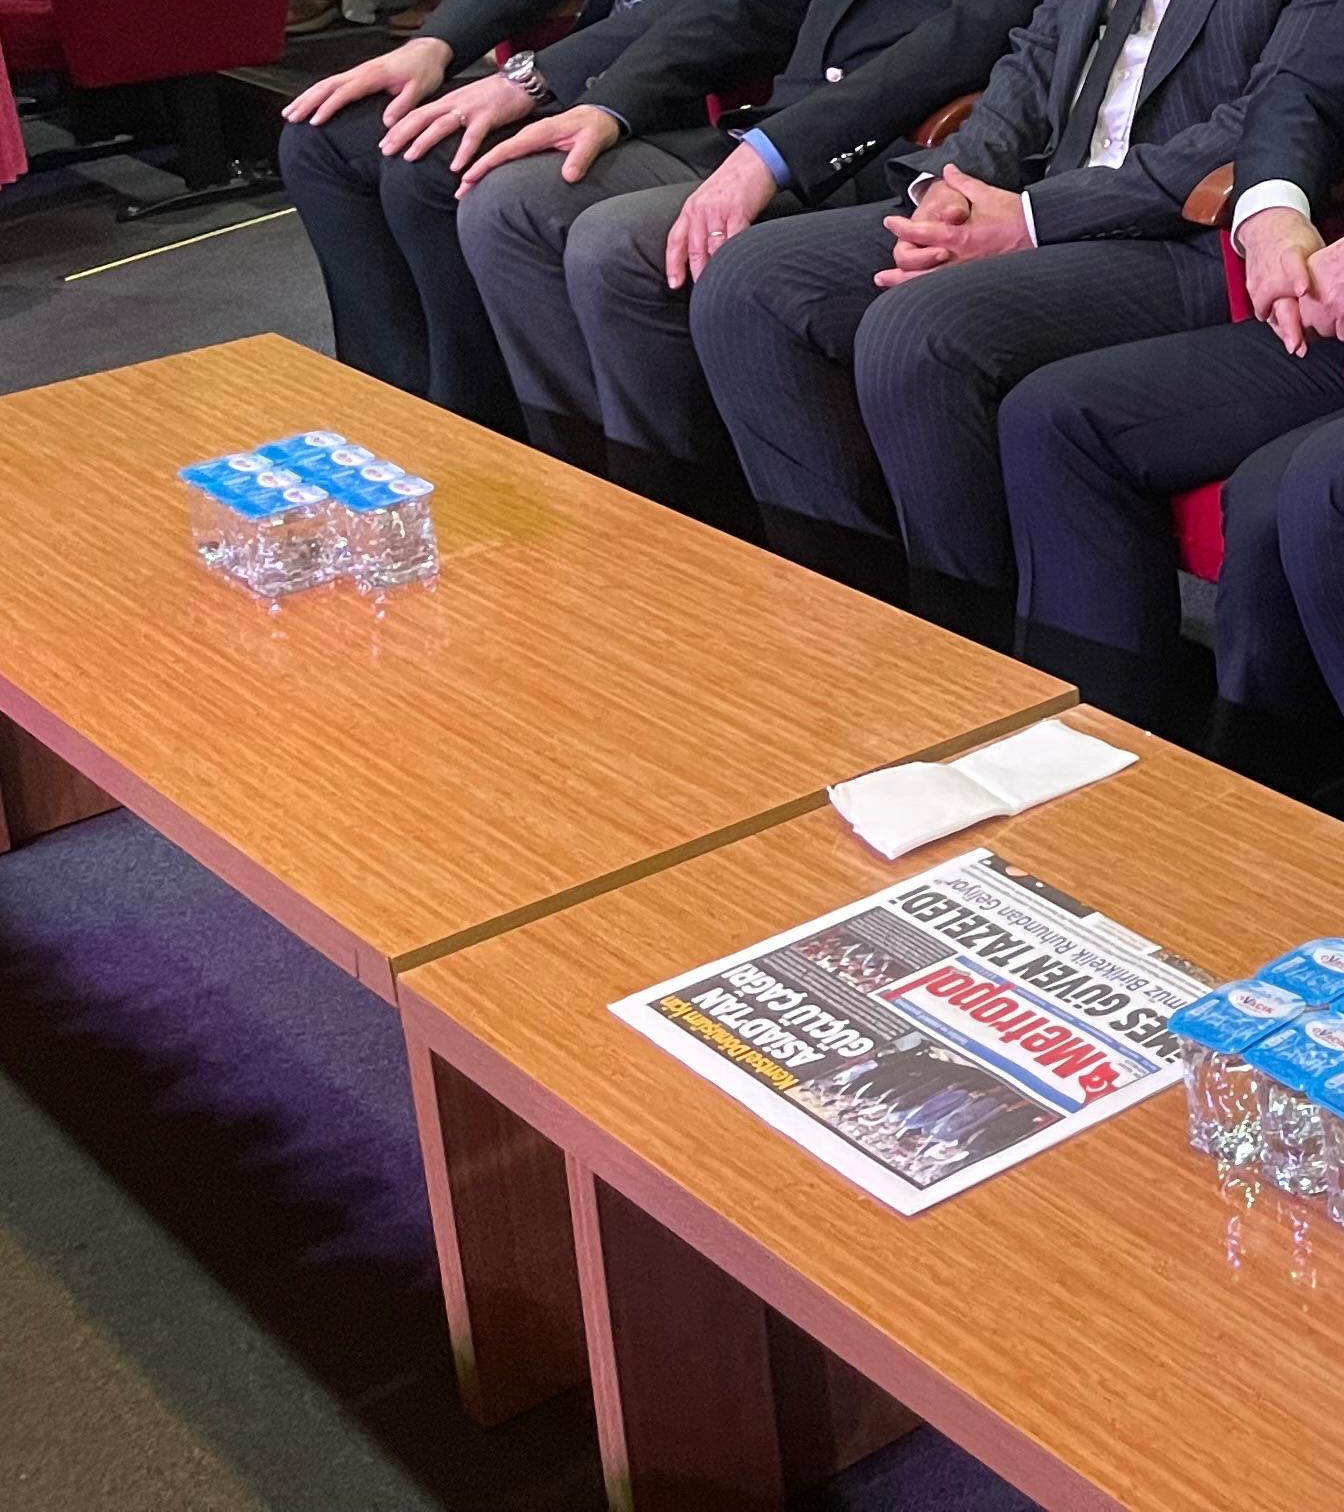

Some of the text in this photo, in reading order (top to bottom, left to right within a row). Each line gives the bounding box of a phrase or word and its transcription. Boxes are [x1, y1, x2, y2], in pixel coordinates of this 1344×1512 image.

[887, 885, 1034, 968] TAZELEDİ
[995, 908, 1077, 954] Ruhundan
[719, 963, 806, 1014] ÇAĞRI
[1008, 955, 1130, 1016] GÜVEN
[1069, 950, 1148, 992] Birliktelik
[777, 1003, 873, 1058] GÜÇLÜ
[878, 965, 1107, 1078] Metropol
[734, 1050, 799, 1088] Kentsel
